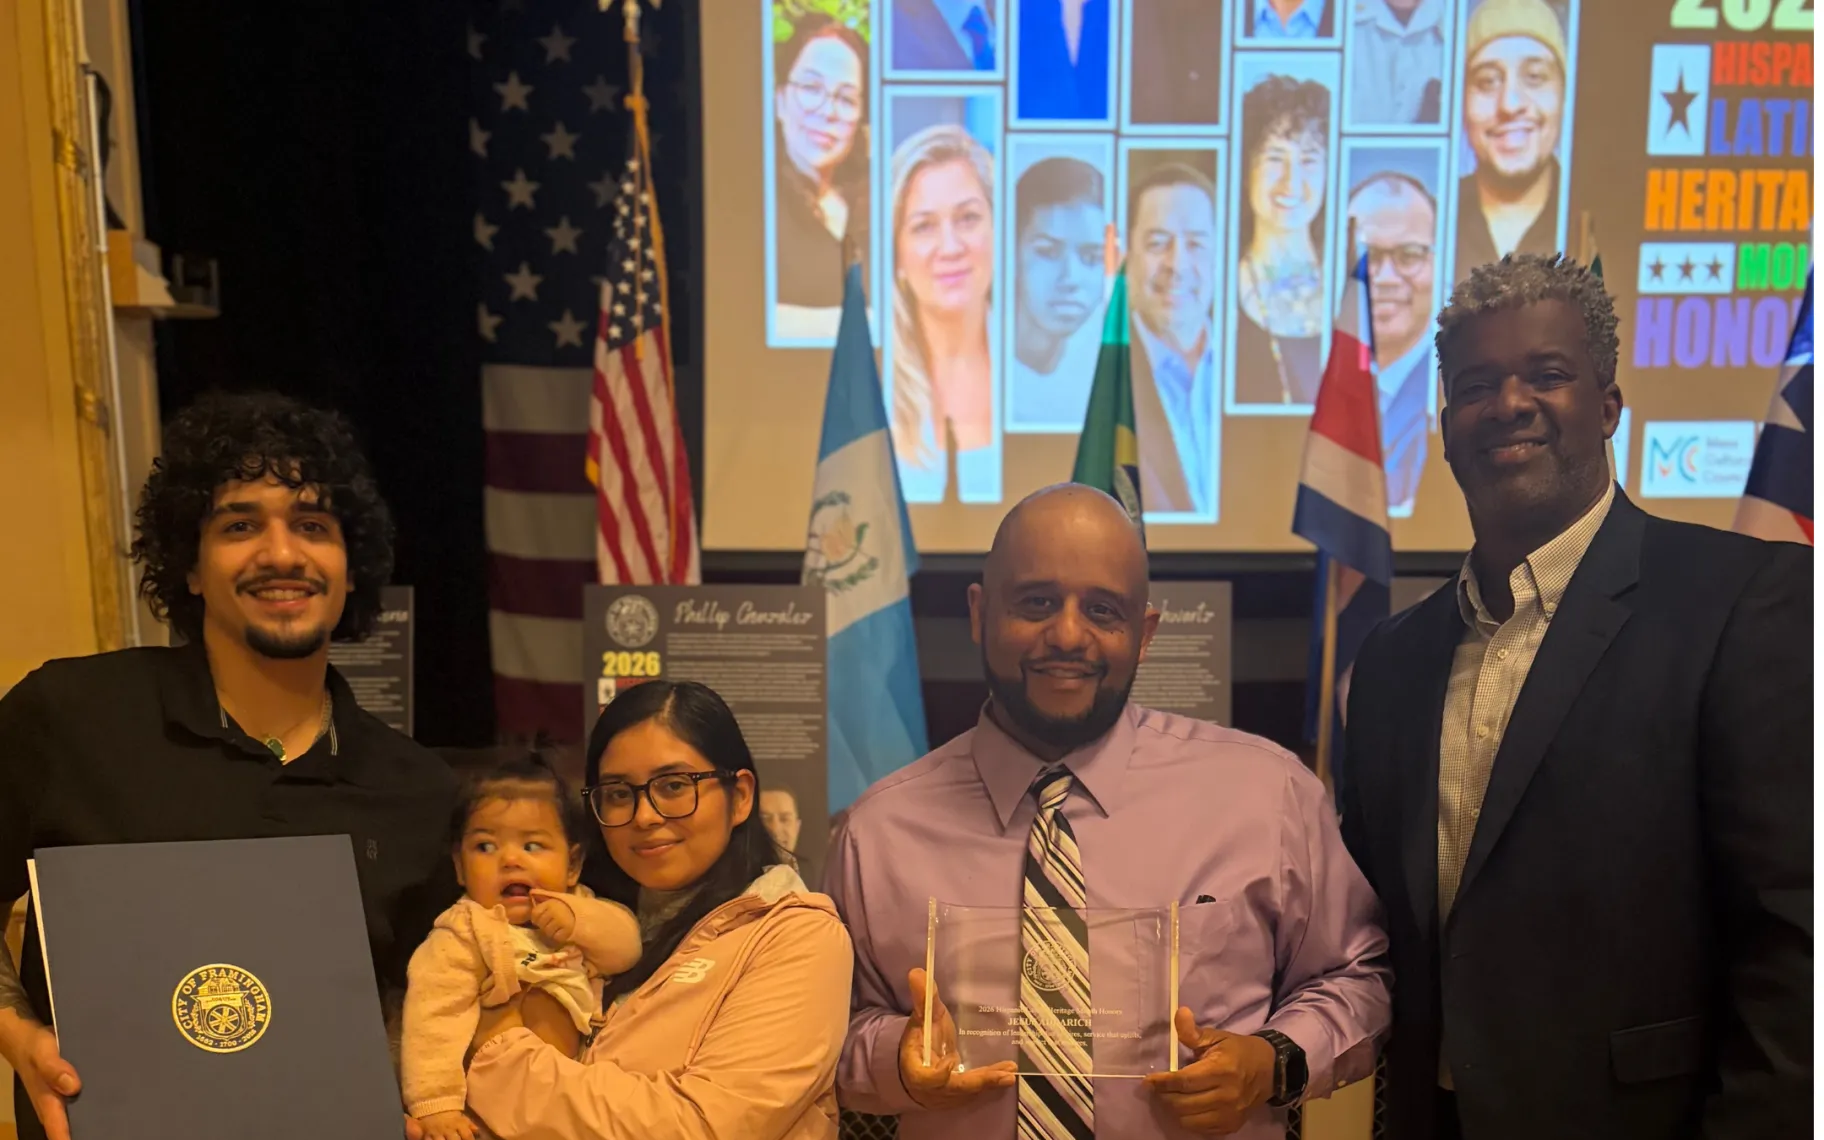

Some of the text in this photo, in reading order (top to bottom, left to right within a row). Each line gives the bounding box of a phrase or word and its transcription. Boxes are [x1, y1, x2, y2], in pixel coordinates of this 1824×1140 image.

[1709, 98, 1814, 157] LATI
[1644, 168, 1814, 231] HERITA
[1633, 296, 1801, 368] HONO
[602, 651, 661, 676] 2026
[178, 968, 267, 1030] CITY OF FRAMINGHAM
[978, 1005, 995, 1013] 2026
[1098, 1007, 1123, 1015] Honors
[958, 1028, 966, 1036] In
[966, 1028, 1002, 1037] recognition
